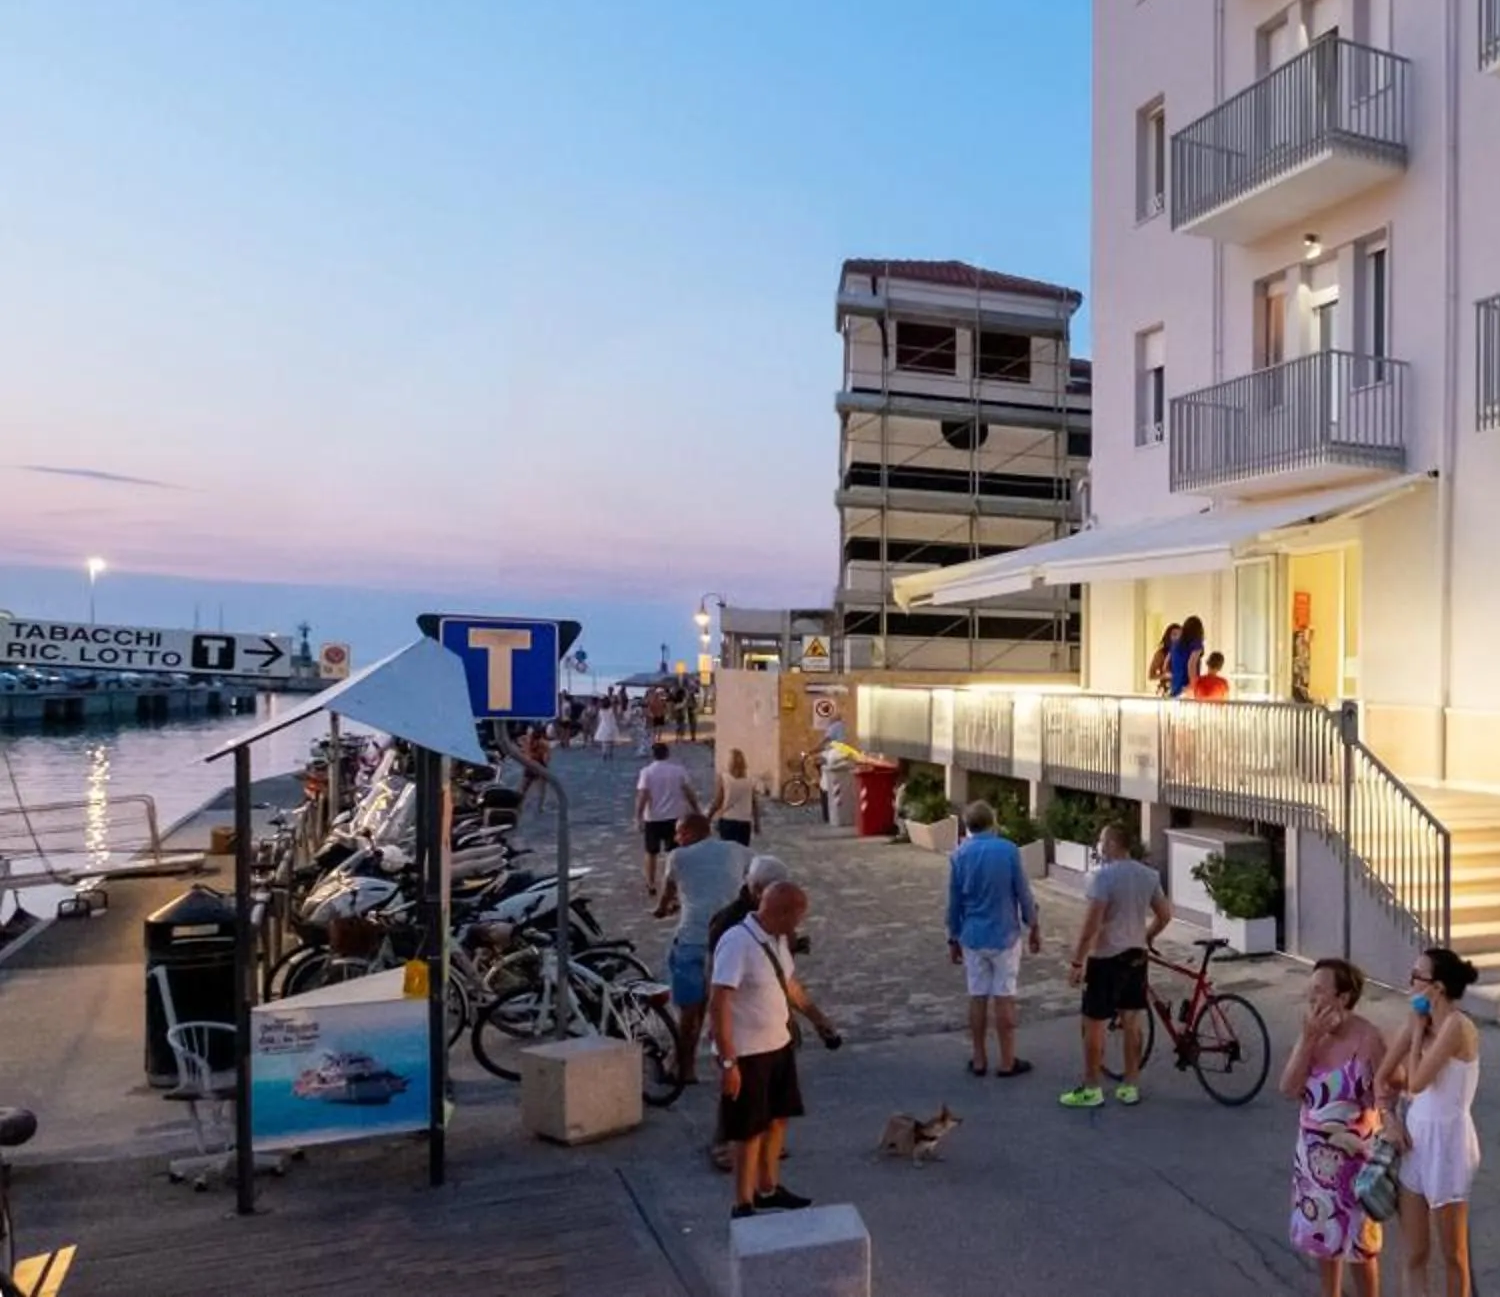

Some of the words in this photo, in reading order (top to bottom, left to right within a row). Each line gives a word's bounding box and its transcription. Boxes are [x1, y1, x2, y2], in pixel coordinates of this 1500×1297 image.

[8, 622, 162, 647] TABACCHI
[6, 642, 68, 661] RIC.
[79, 646, 181, 667] LOTTO
[201, 639, 227, 666] T
[467, 627, 532, 711] T
